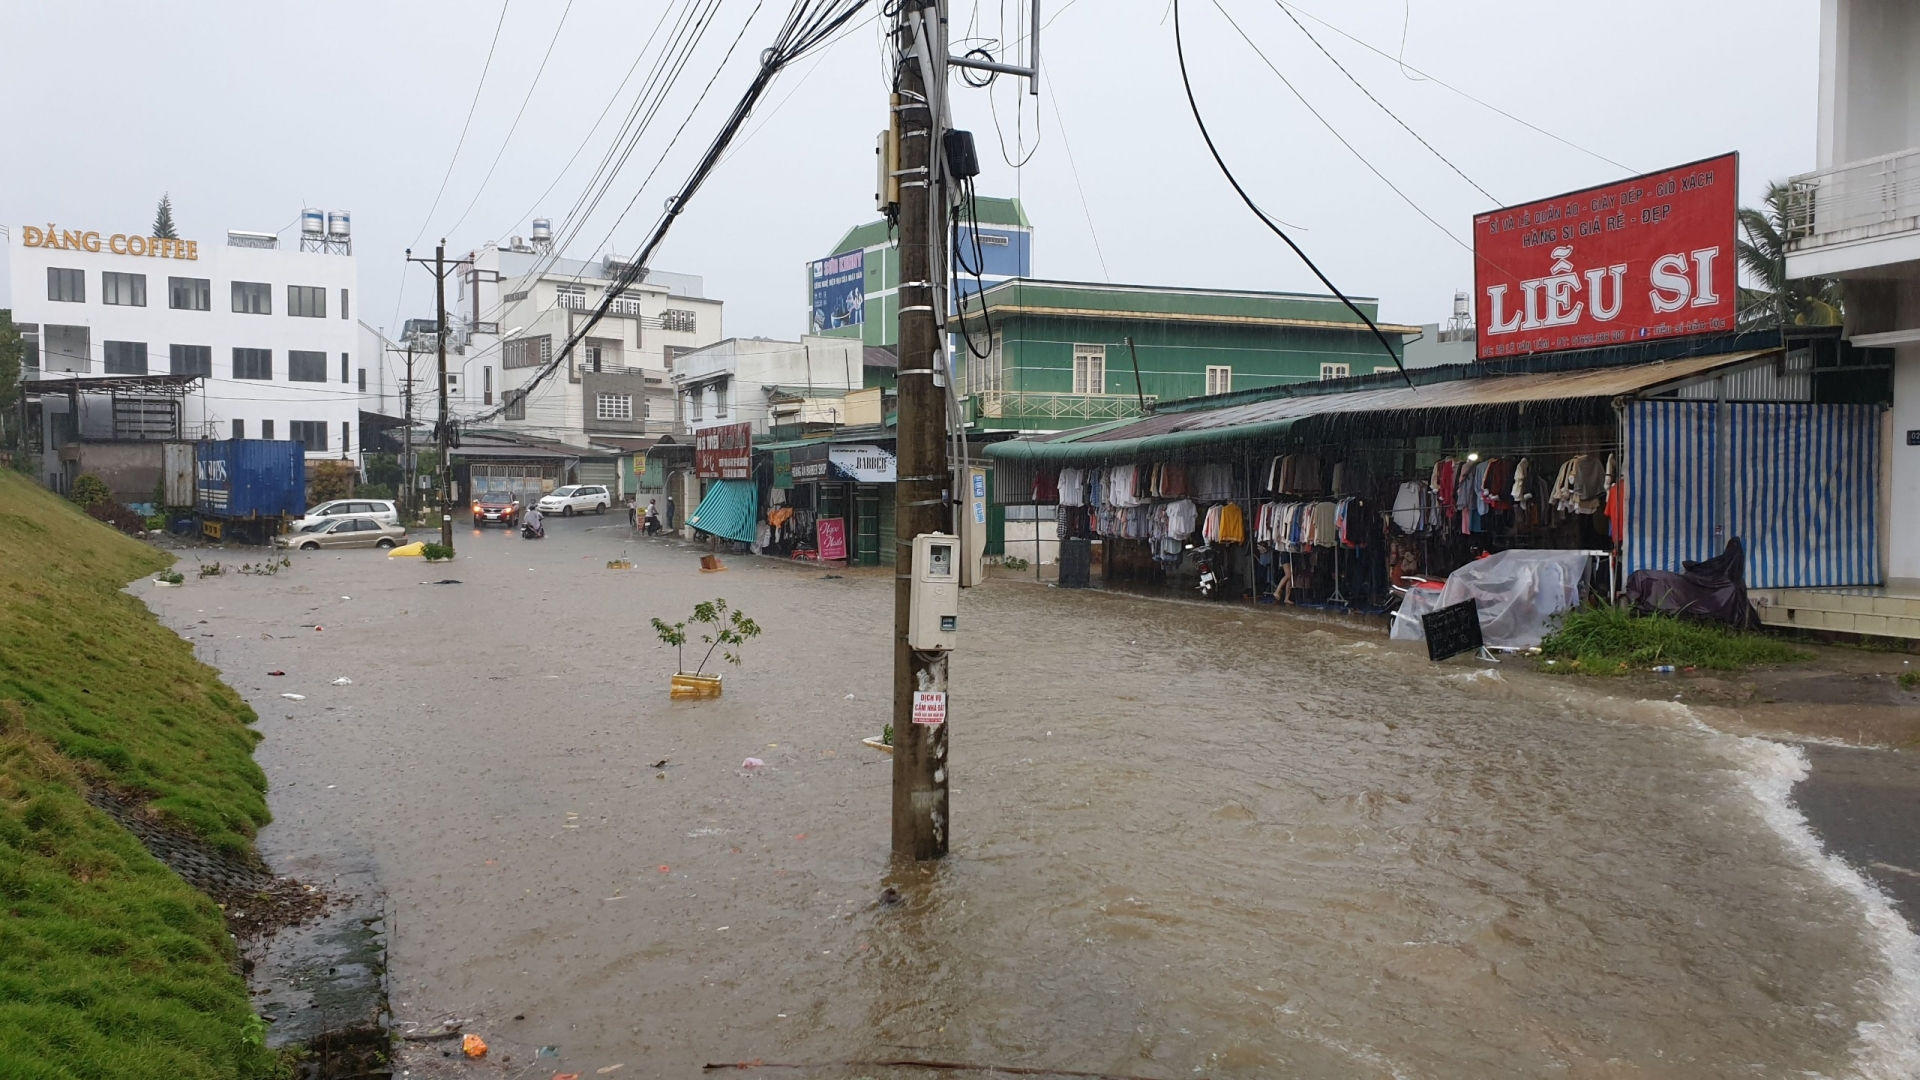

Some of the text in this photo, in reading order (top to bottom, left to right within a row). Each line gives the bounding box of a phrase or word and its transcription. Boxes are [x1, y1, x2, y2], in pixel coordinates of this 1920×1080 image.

[1502, 214, 1515, 232] VÀ
[1534, 203, 1561, 225] QUẦN
[1565, 201, 1579, 218] ÁO
[1591, 193, 1616, 213] GIÀY
[1681, 170, 1714, 193] XÁCH
[23, 222, 199, 261] ĐĂNG COFFEE
[1522, 203, 1672, 249] HÀNG SI GIÁ RẺ ĐẸP
[1487, 245, 1719, 335] LIỄU SI
[857, 457, 887, 470] BARBER
